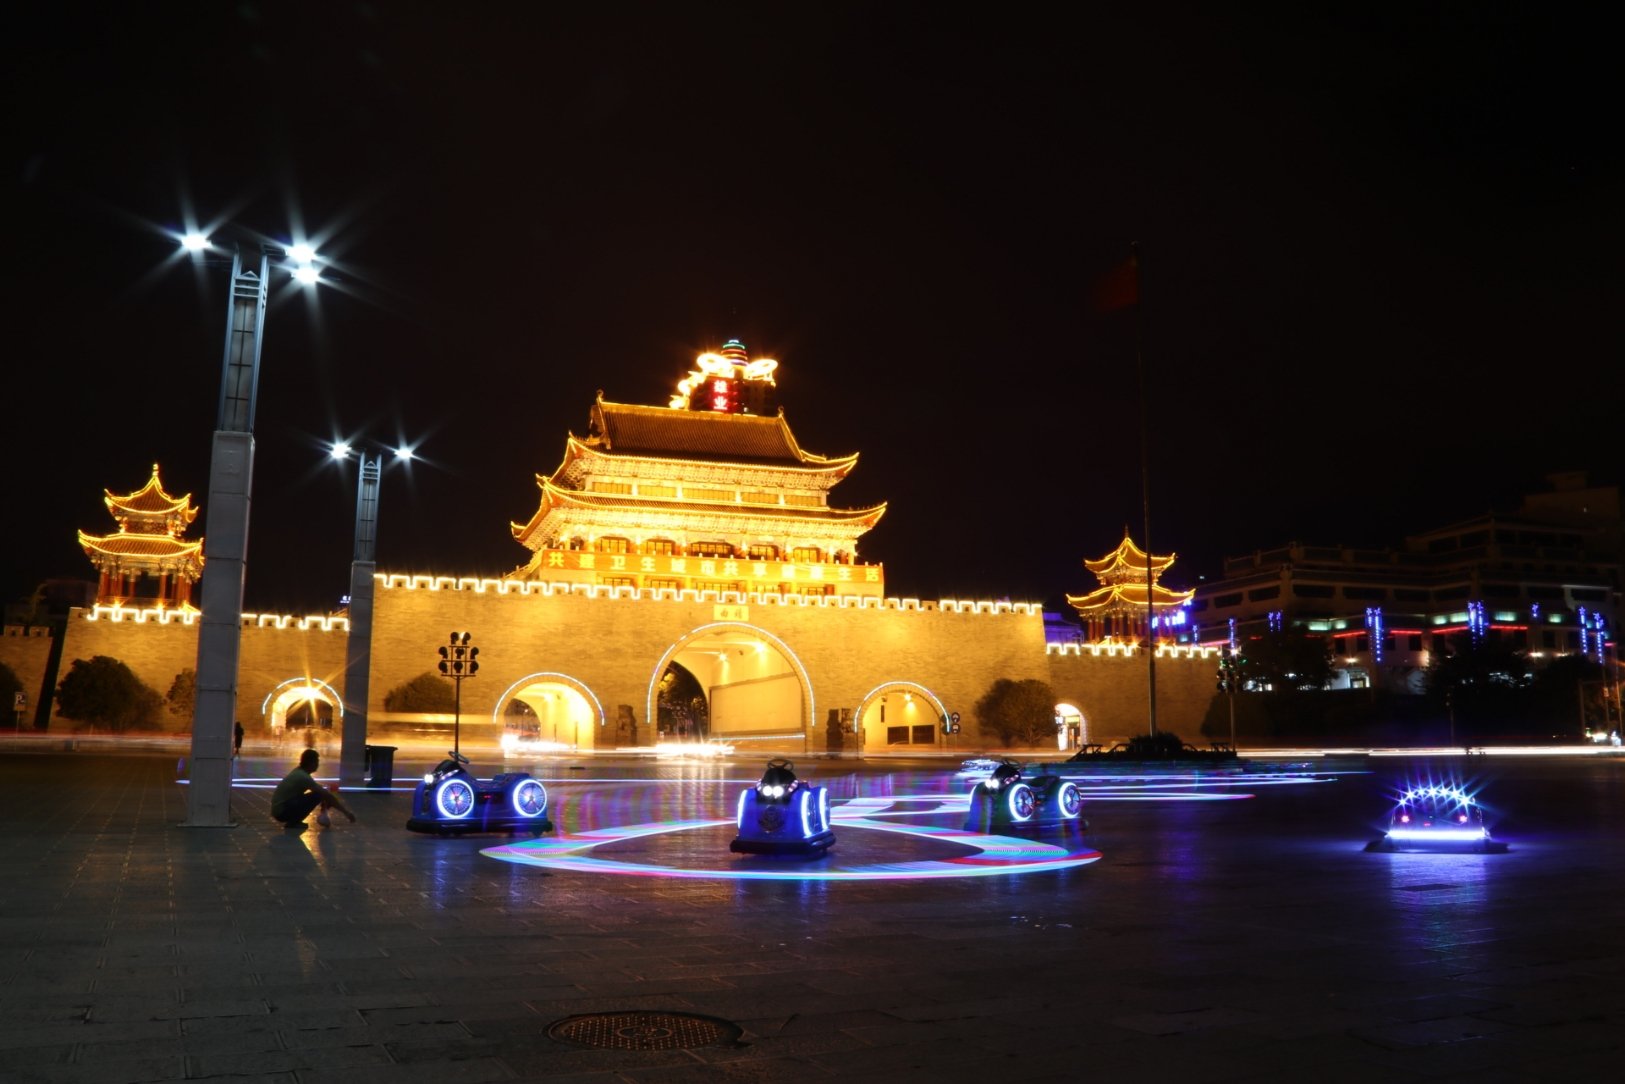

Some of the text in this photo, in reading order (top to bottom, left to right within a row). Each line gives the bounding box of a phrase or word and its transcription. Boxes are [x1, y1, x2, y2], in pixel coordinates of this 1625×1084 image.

[548, 552, 878, 581] 共建卫生城市共享生活
